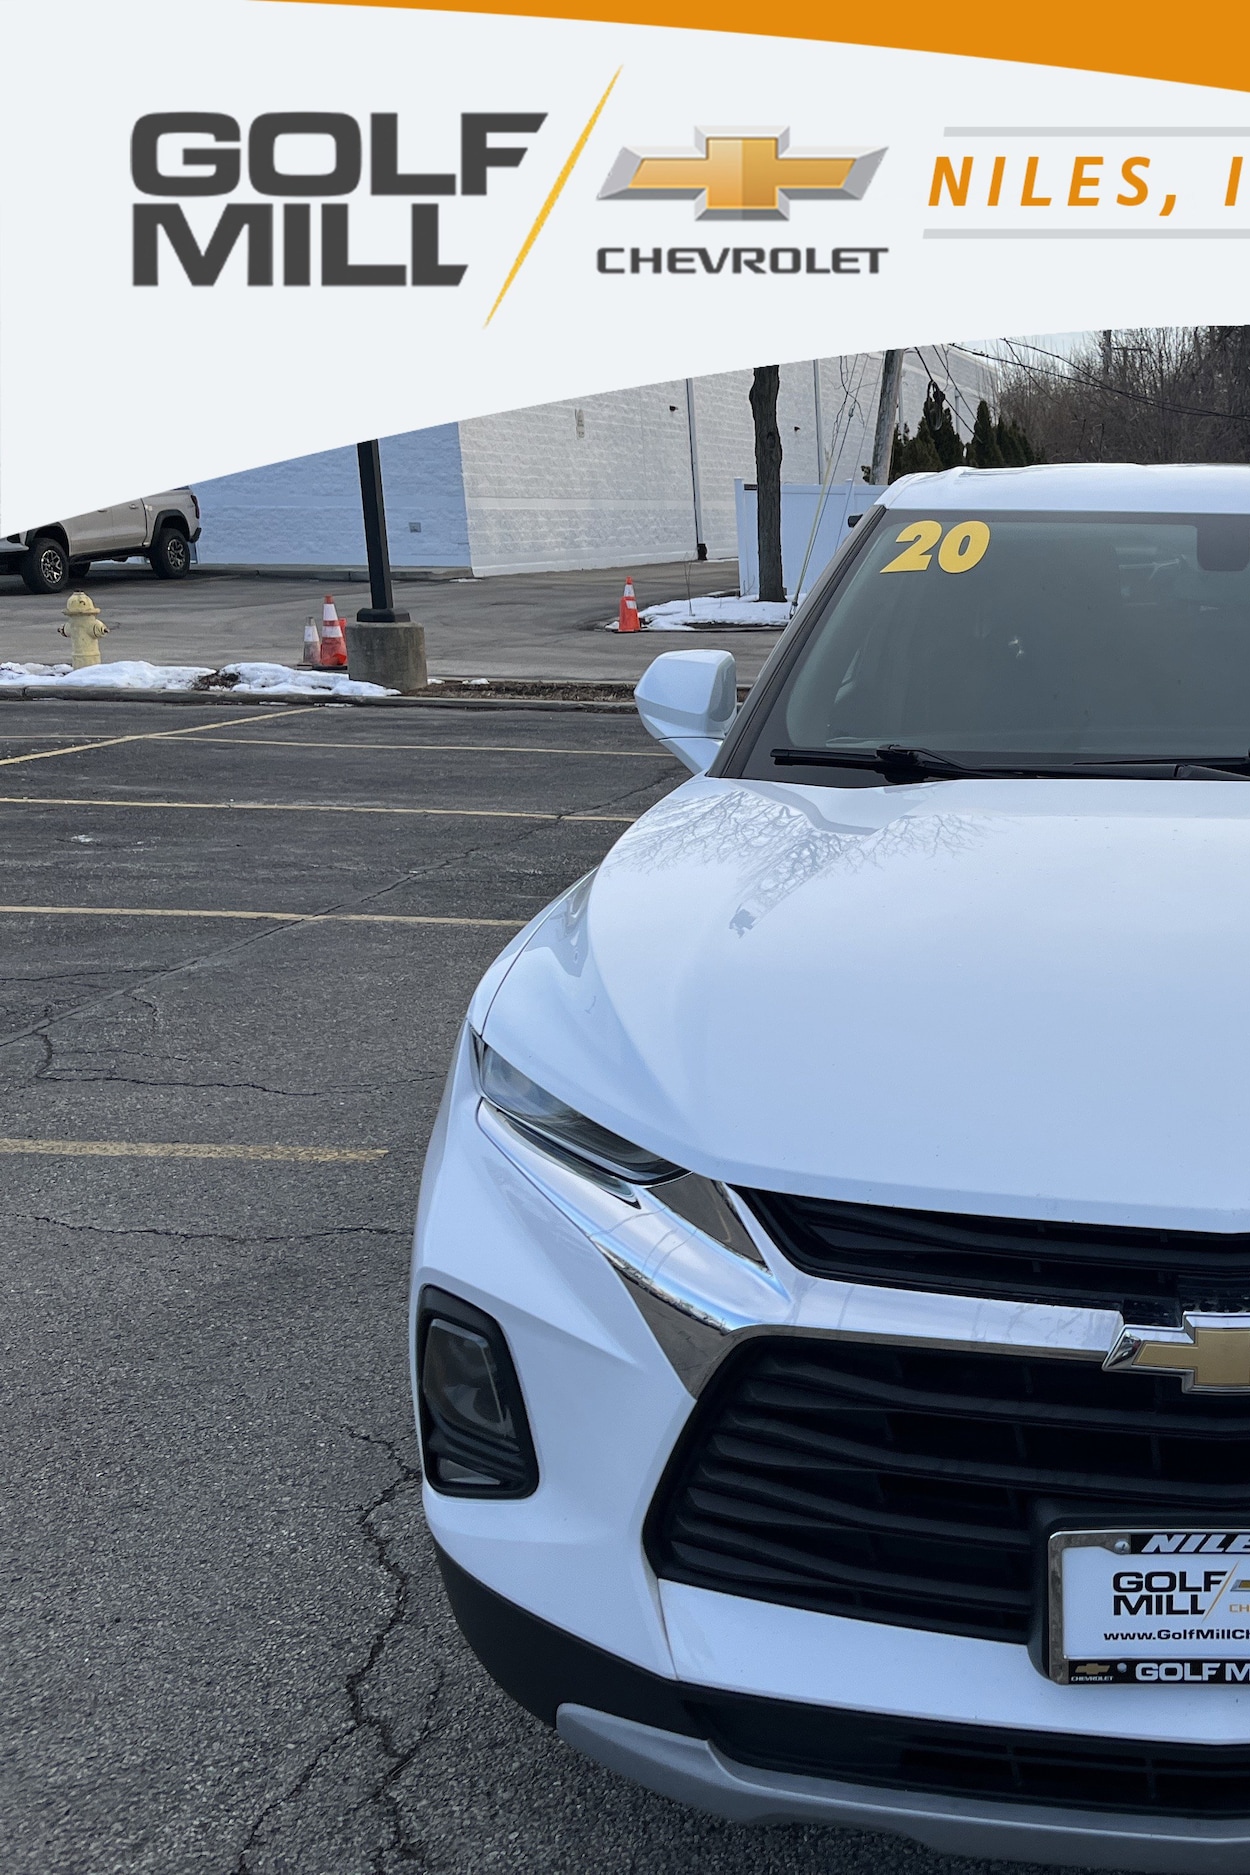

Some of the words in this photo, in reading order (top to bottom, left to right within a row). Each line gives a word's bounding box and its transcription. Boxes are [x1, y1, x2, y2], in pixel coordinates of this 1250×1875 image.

[880, 520, 990, 574] 20
[1113, 1570, 1228, 1593] GOLF
[1113, 1595, 1207, 1616] MILL
[1135, 1662, 1221, 1681] GOLF
